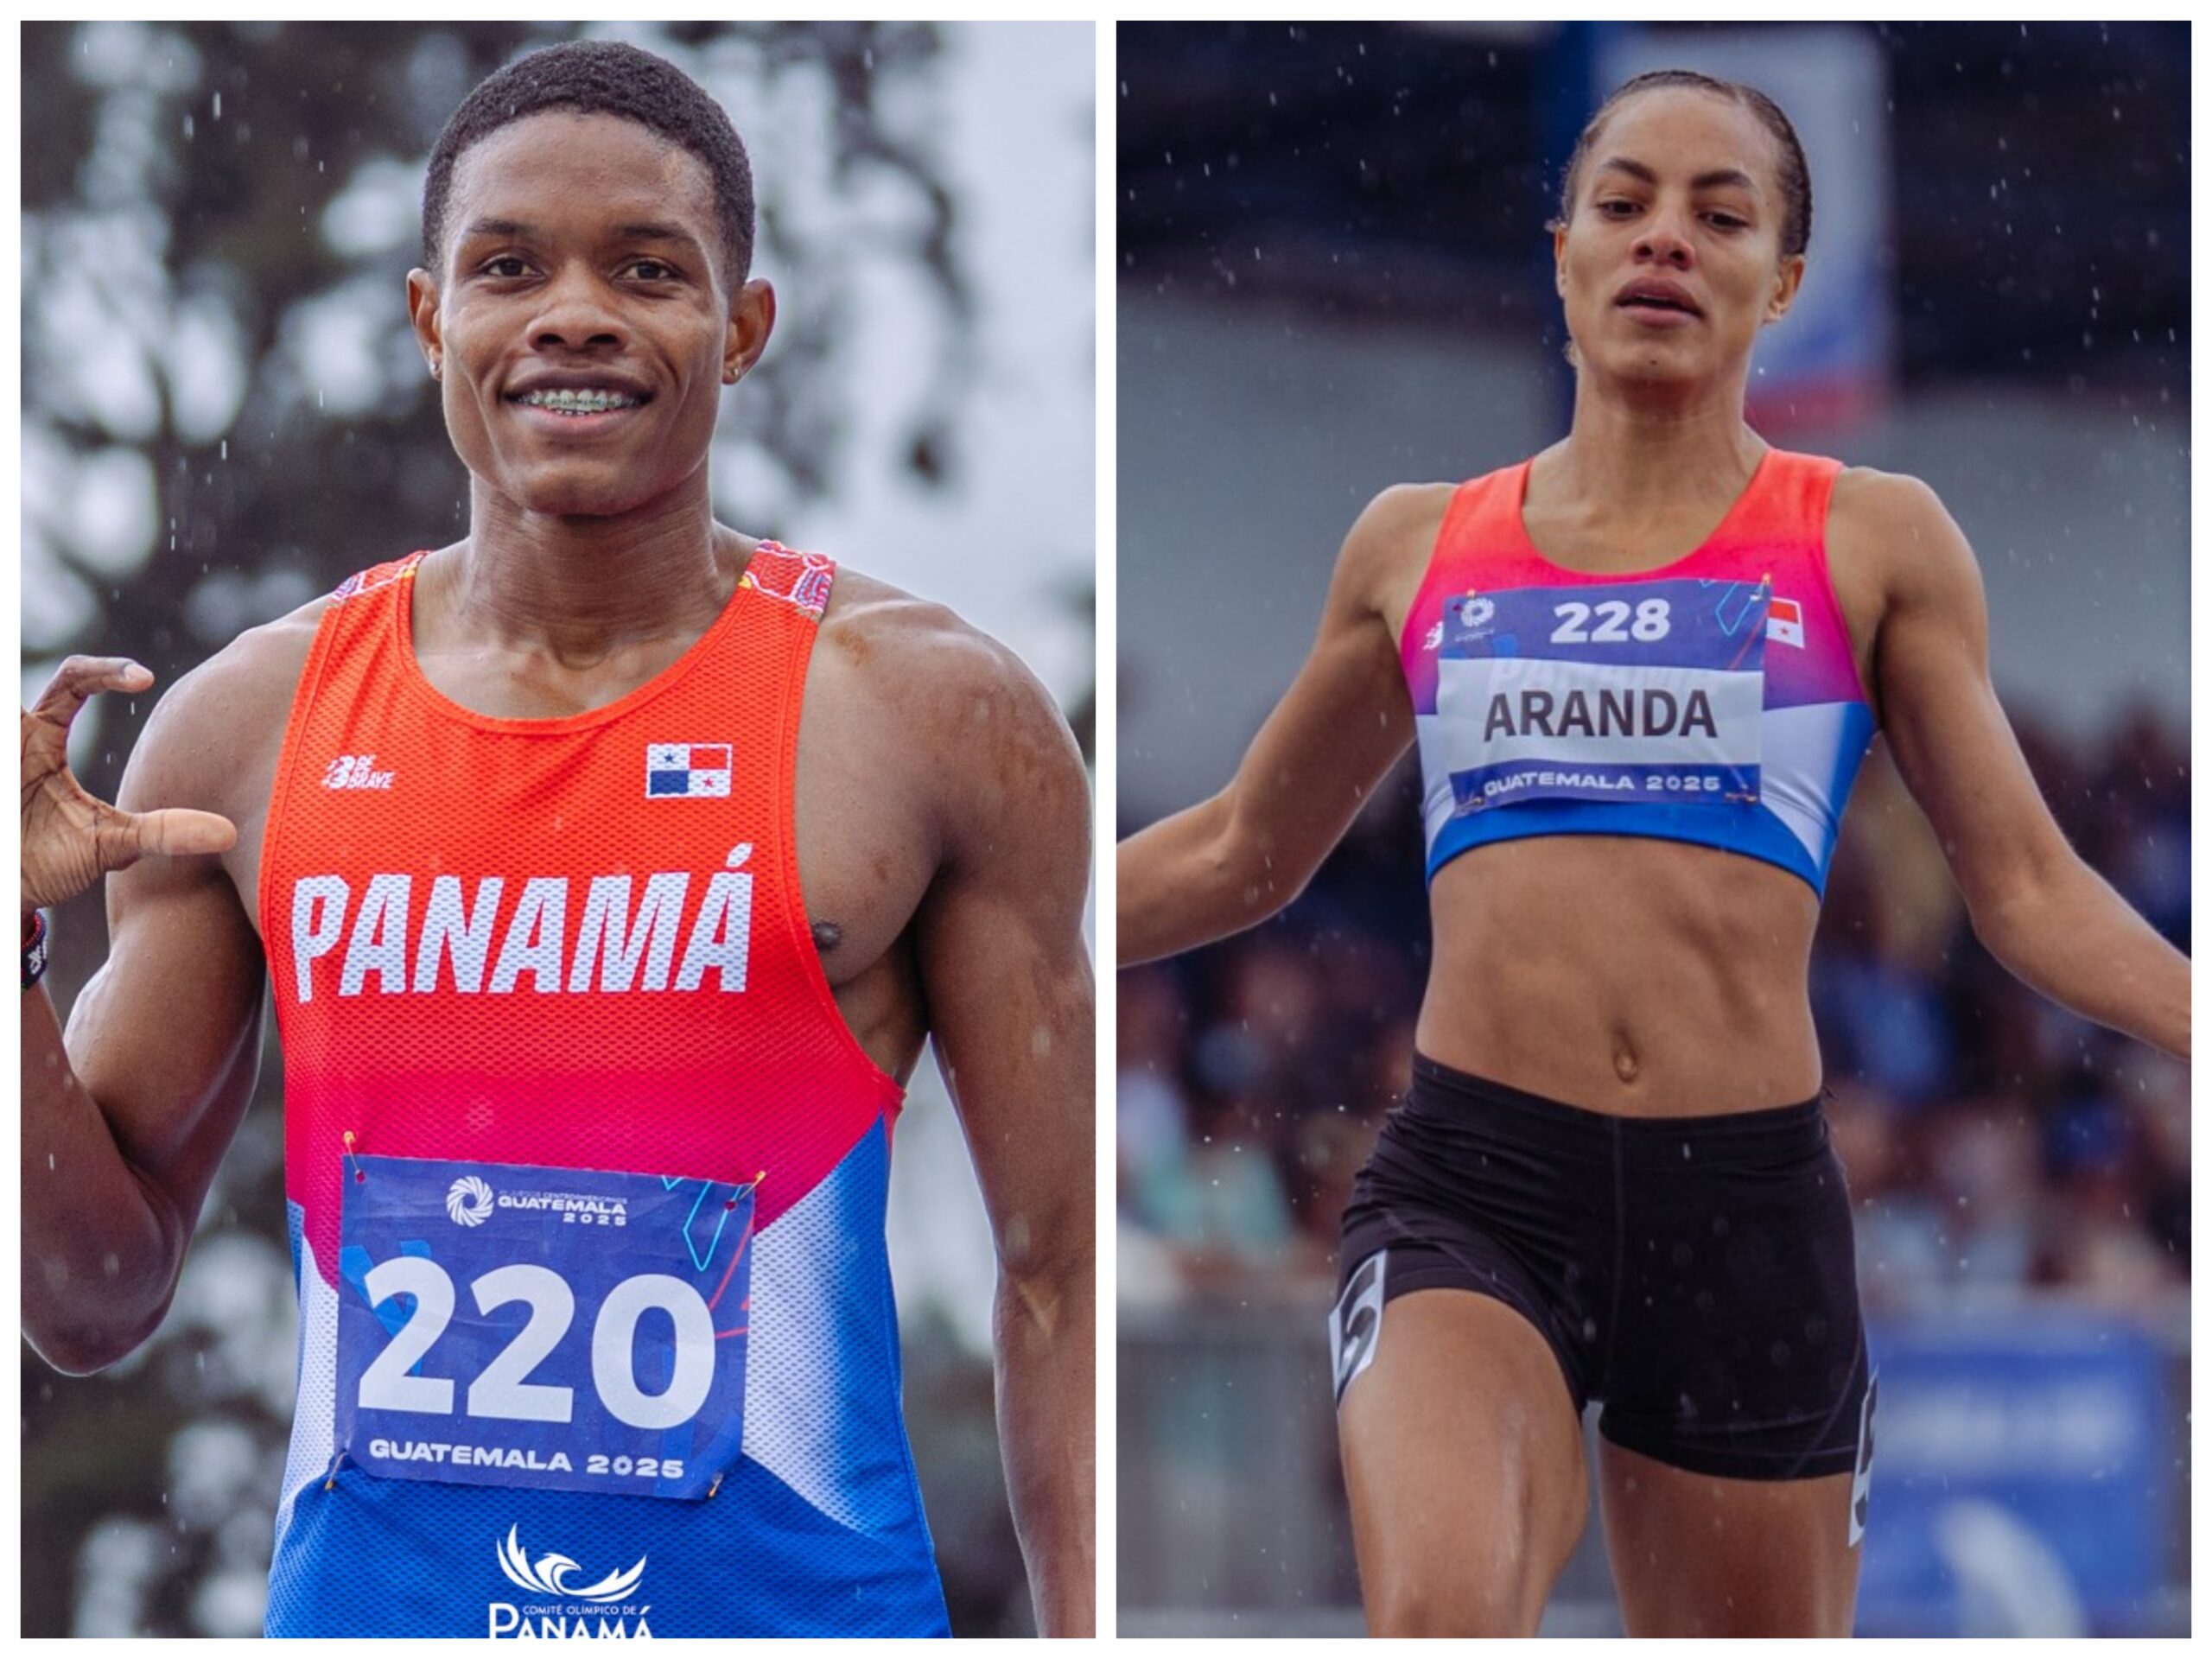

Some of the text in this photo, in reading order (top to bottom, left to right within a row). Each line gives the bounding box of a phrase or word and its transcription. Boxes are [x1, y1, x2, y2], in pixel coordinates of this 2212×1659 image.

[1549, 598, 1671, 644] 228
[1483, 688, 1719, 743] ARANDA
[347, 770, 397, 790] BRAVE
[1483, 771, 1721, 797] GUATEMALA 2025
[290, 842, 754, 1003] PANAMÁ
[498, 1194, 627, 1216] GUATEMALA
[563, 1211, 627, 1227] 2025
[358, 1255, 716, 1430] 220
[368, 1438, 685, 1479] GUATEMALA 2025
[488, 1602, 654, 1639] PANAMÁ
[522, 1603, 637, 1616] COMITÉ OLÍMPICO DE
